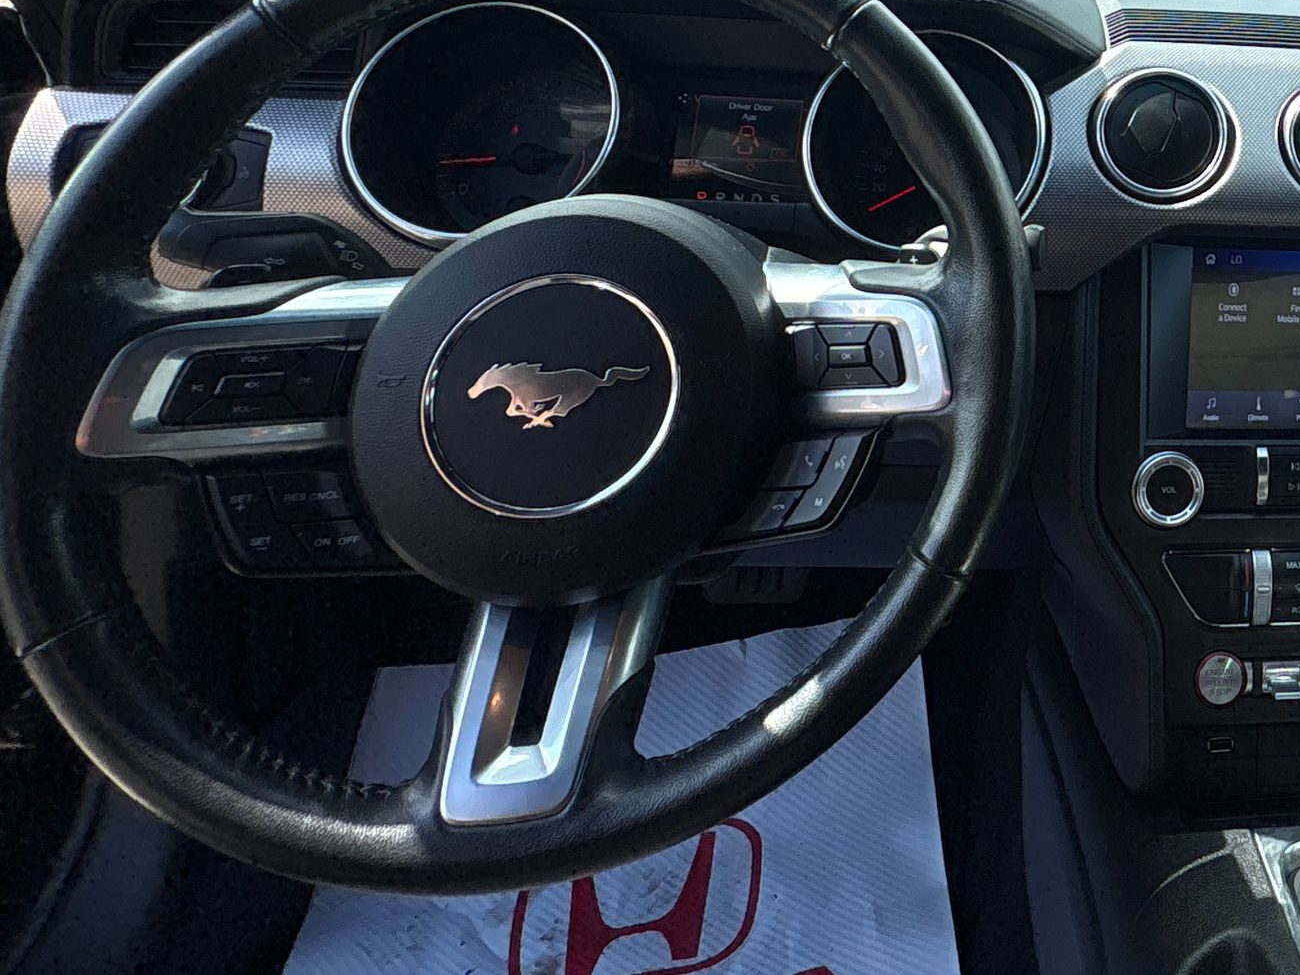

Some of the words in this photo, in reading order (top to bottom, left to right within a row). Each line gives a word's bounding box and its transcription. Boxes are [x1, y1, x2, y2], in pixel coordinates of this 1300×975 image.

[728, 102, 752, 111] Driver
[753, 103, 774, 113] Door
[1230, 254, 1243, 266] LO
[1218, 302, 1247, 313] Connect
[1223, 312, 1247, 323] Device
[1277, 314, 1300, 325] Mobile
[841, 352, 853, 361] OK
[1203, 414, 1220, 422] Audio
[1247, 413, 1269, 422] Climate
[1161, 485, 1177, 494] VOL
[283, 492, 306, 502] RES
[308, 490, 341, 502] CNCL
[813, 497, 824, 507] M
[249, 536, 273, 547] SET
[313, 537, 332, 546] ON
[336, 535, 361, 546] OFF
